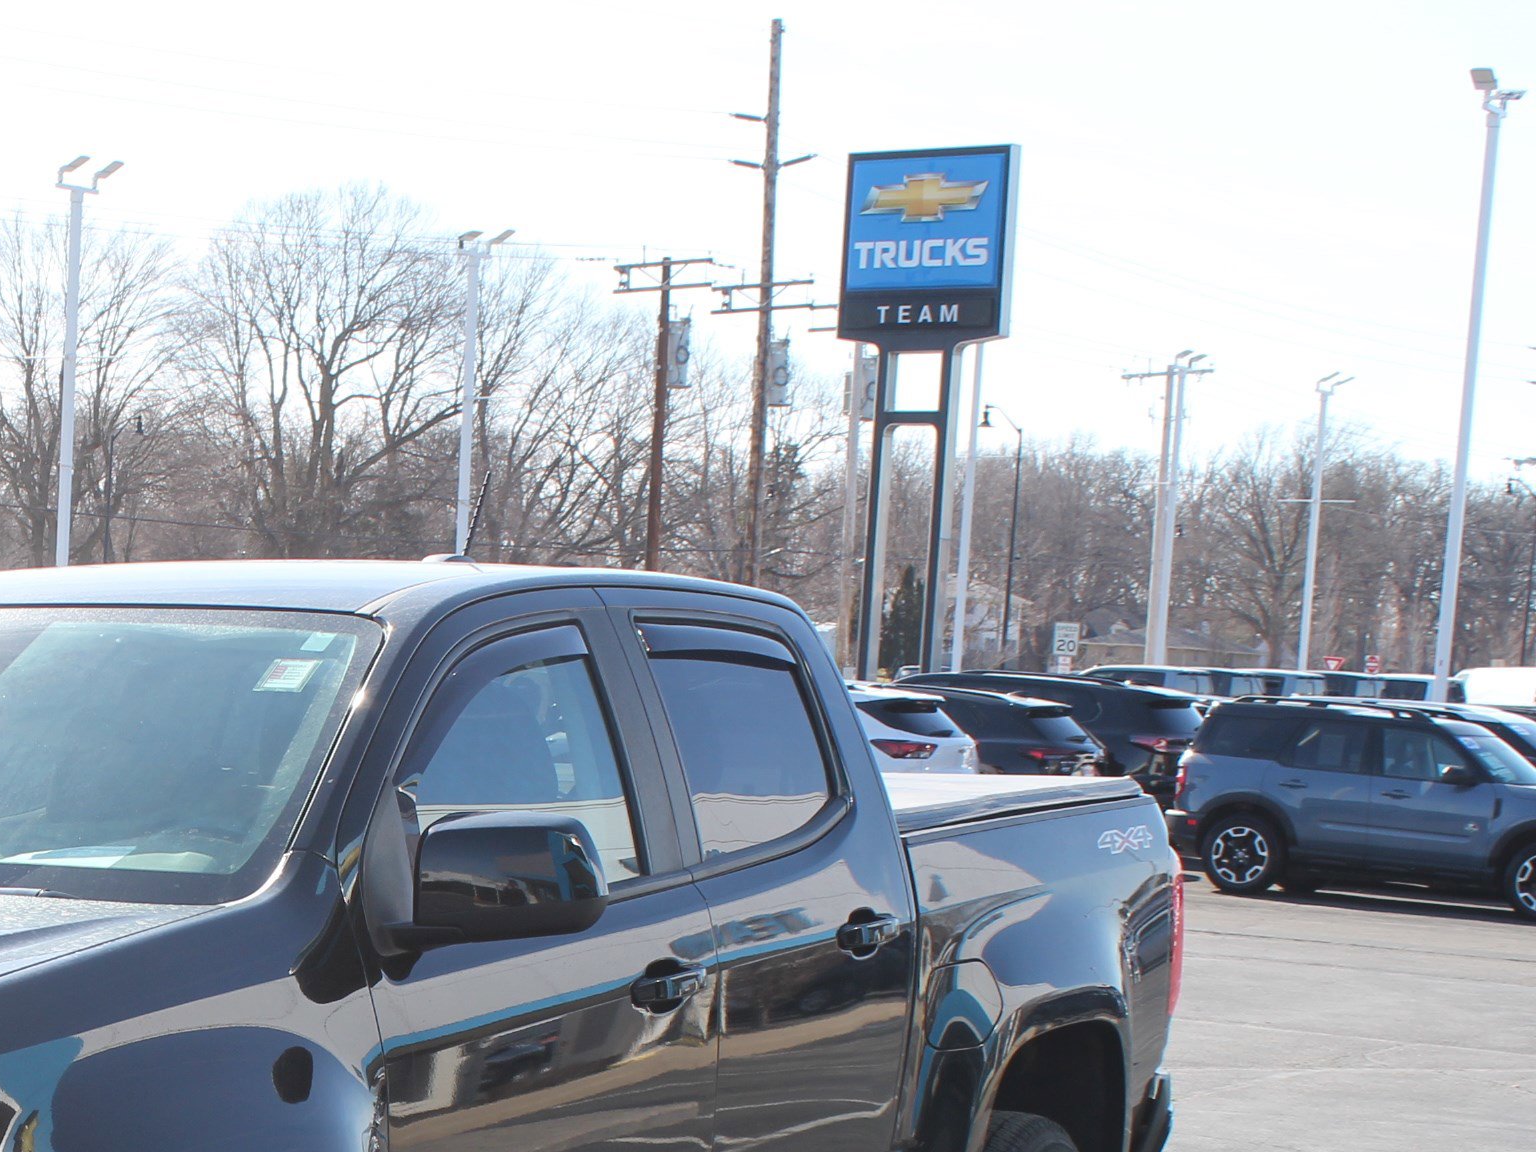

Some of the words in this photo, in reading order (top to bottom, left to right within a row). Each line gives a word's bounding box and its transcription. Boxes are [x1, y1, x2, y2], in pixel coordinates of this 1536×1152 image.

[854, 237, 990, 270] TRUCKS
[876, 304, 960, 324] TEAM
[1056, 639, 1076, 652] 20
